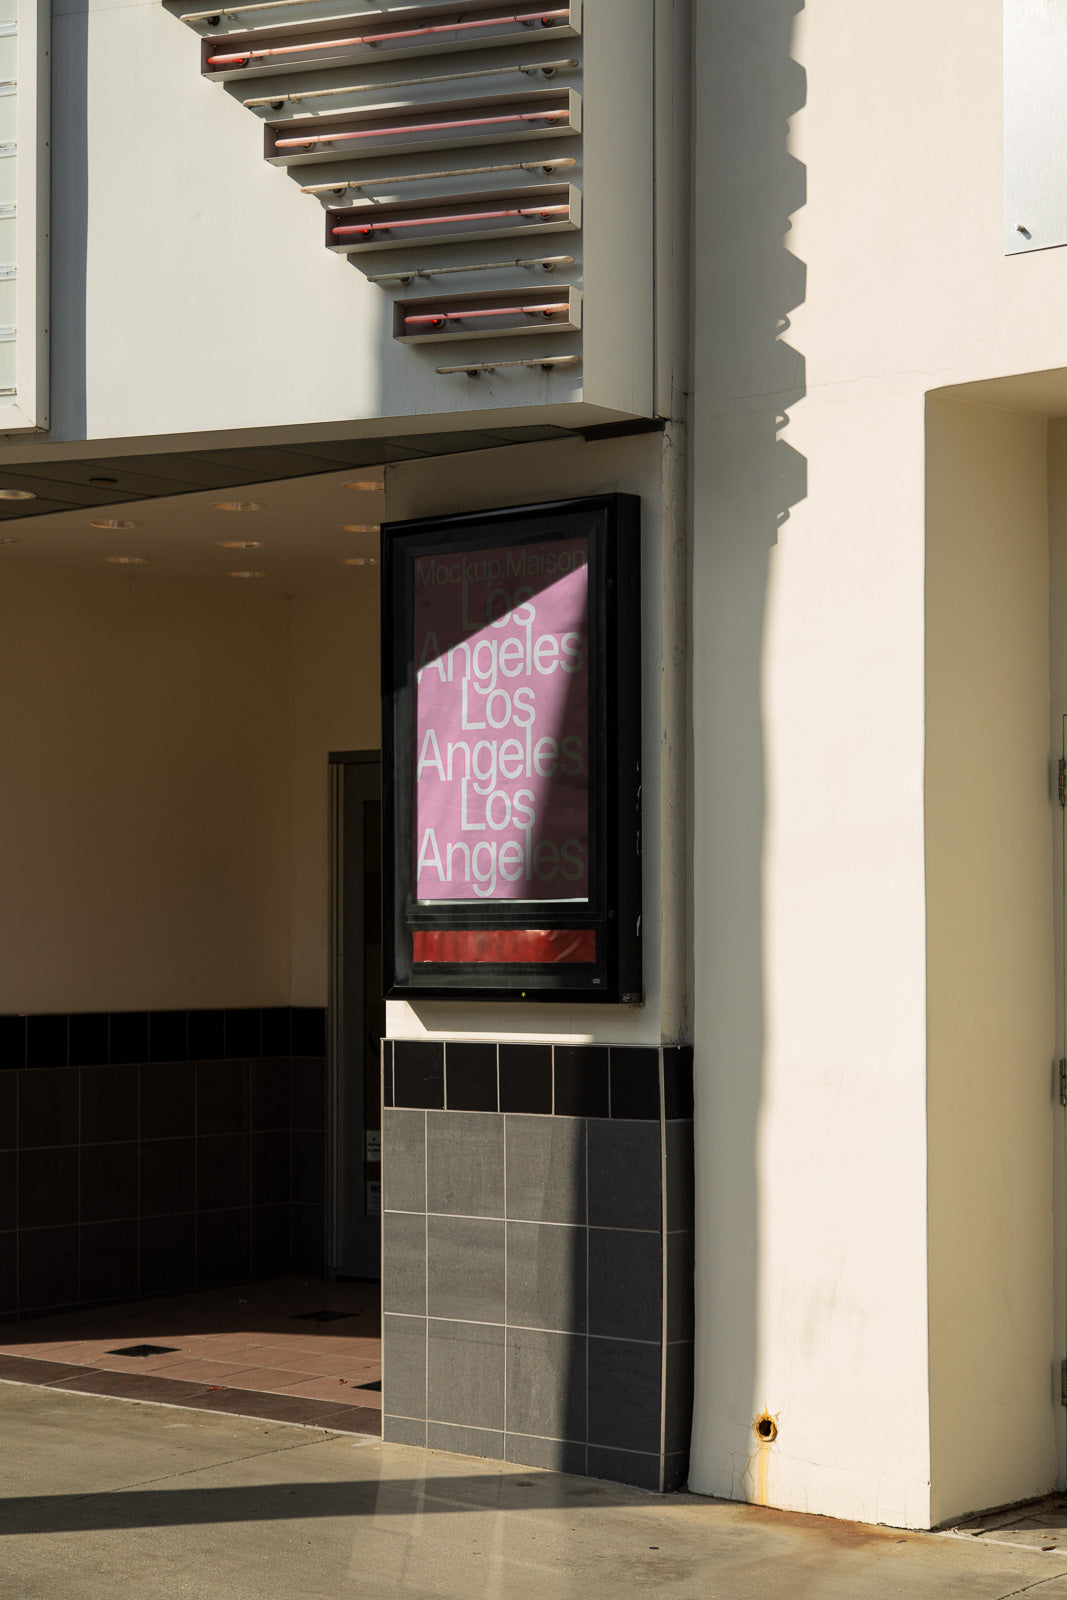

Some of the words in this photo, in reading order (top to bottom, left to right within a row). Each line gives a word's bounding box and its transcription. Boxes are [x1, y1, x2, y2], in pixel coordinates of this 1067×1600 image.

[417, 547, 587, 587] Mockup.Maison
[462, 578, 536, 631] Los
[417, 622, 584, 694] Angeles
[461, 677, 536, 730] Los
[417, 726, 584, 795] Angeles
[461, 777, 536, 831] Los
[417, 825, 584, 897] Angeles
